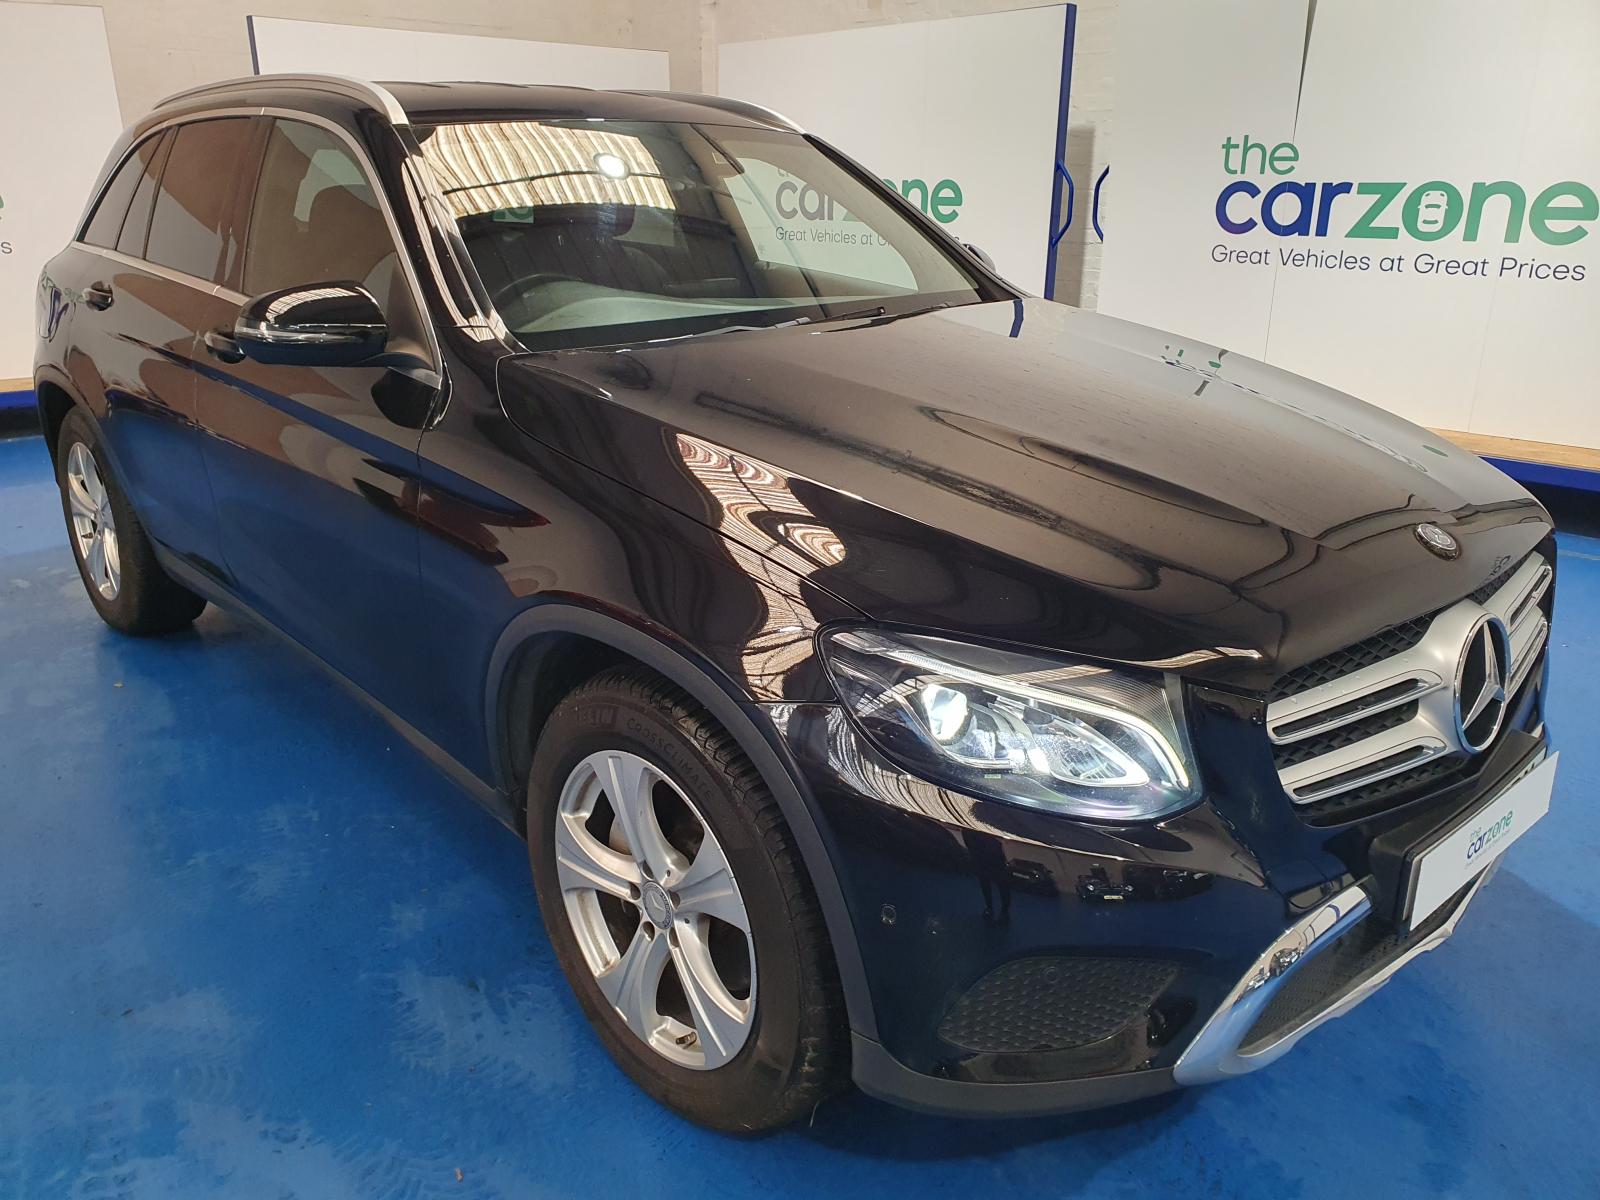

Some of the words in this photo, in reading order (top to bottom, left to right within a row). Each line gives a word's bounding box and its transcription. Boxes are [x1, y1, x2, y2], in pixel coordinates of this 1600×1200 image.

[1222, 135, 1300, 175] the
[1215, 180, 1599, 246] carzone
[775, 227, 807, 241] Great
[810, 228, 857, 245] Vehicles
[861, 233, 873, 246] at
[1211, 244, 1271, 266] Great
[1279, 247, 1371, 271] Vehicles
[1379, 253, 1404, 272] at
[1413, 253, 1489, 277] Great
[1499, 256, 1587, 281] Prices
[1467, 811, 1513, 860] carzone
